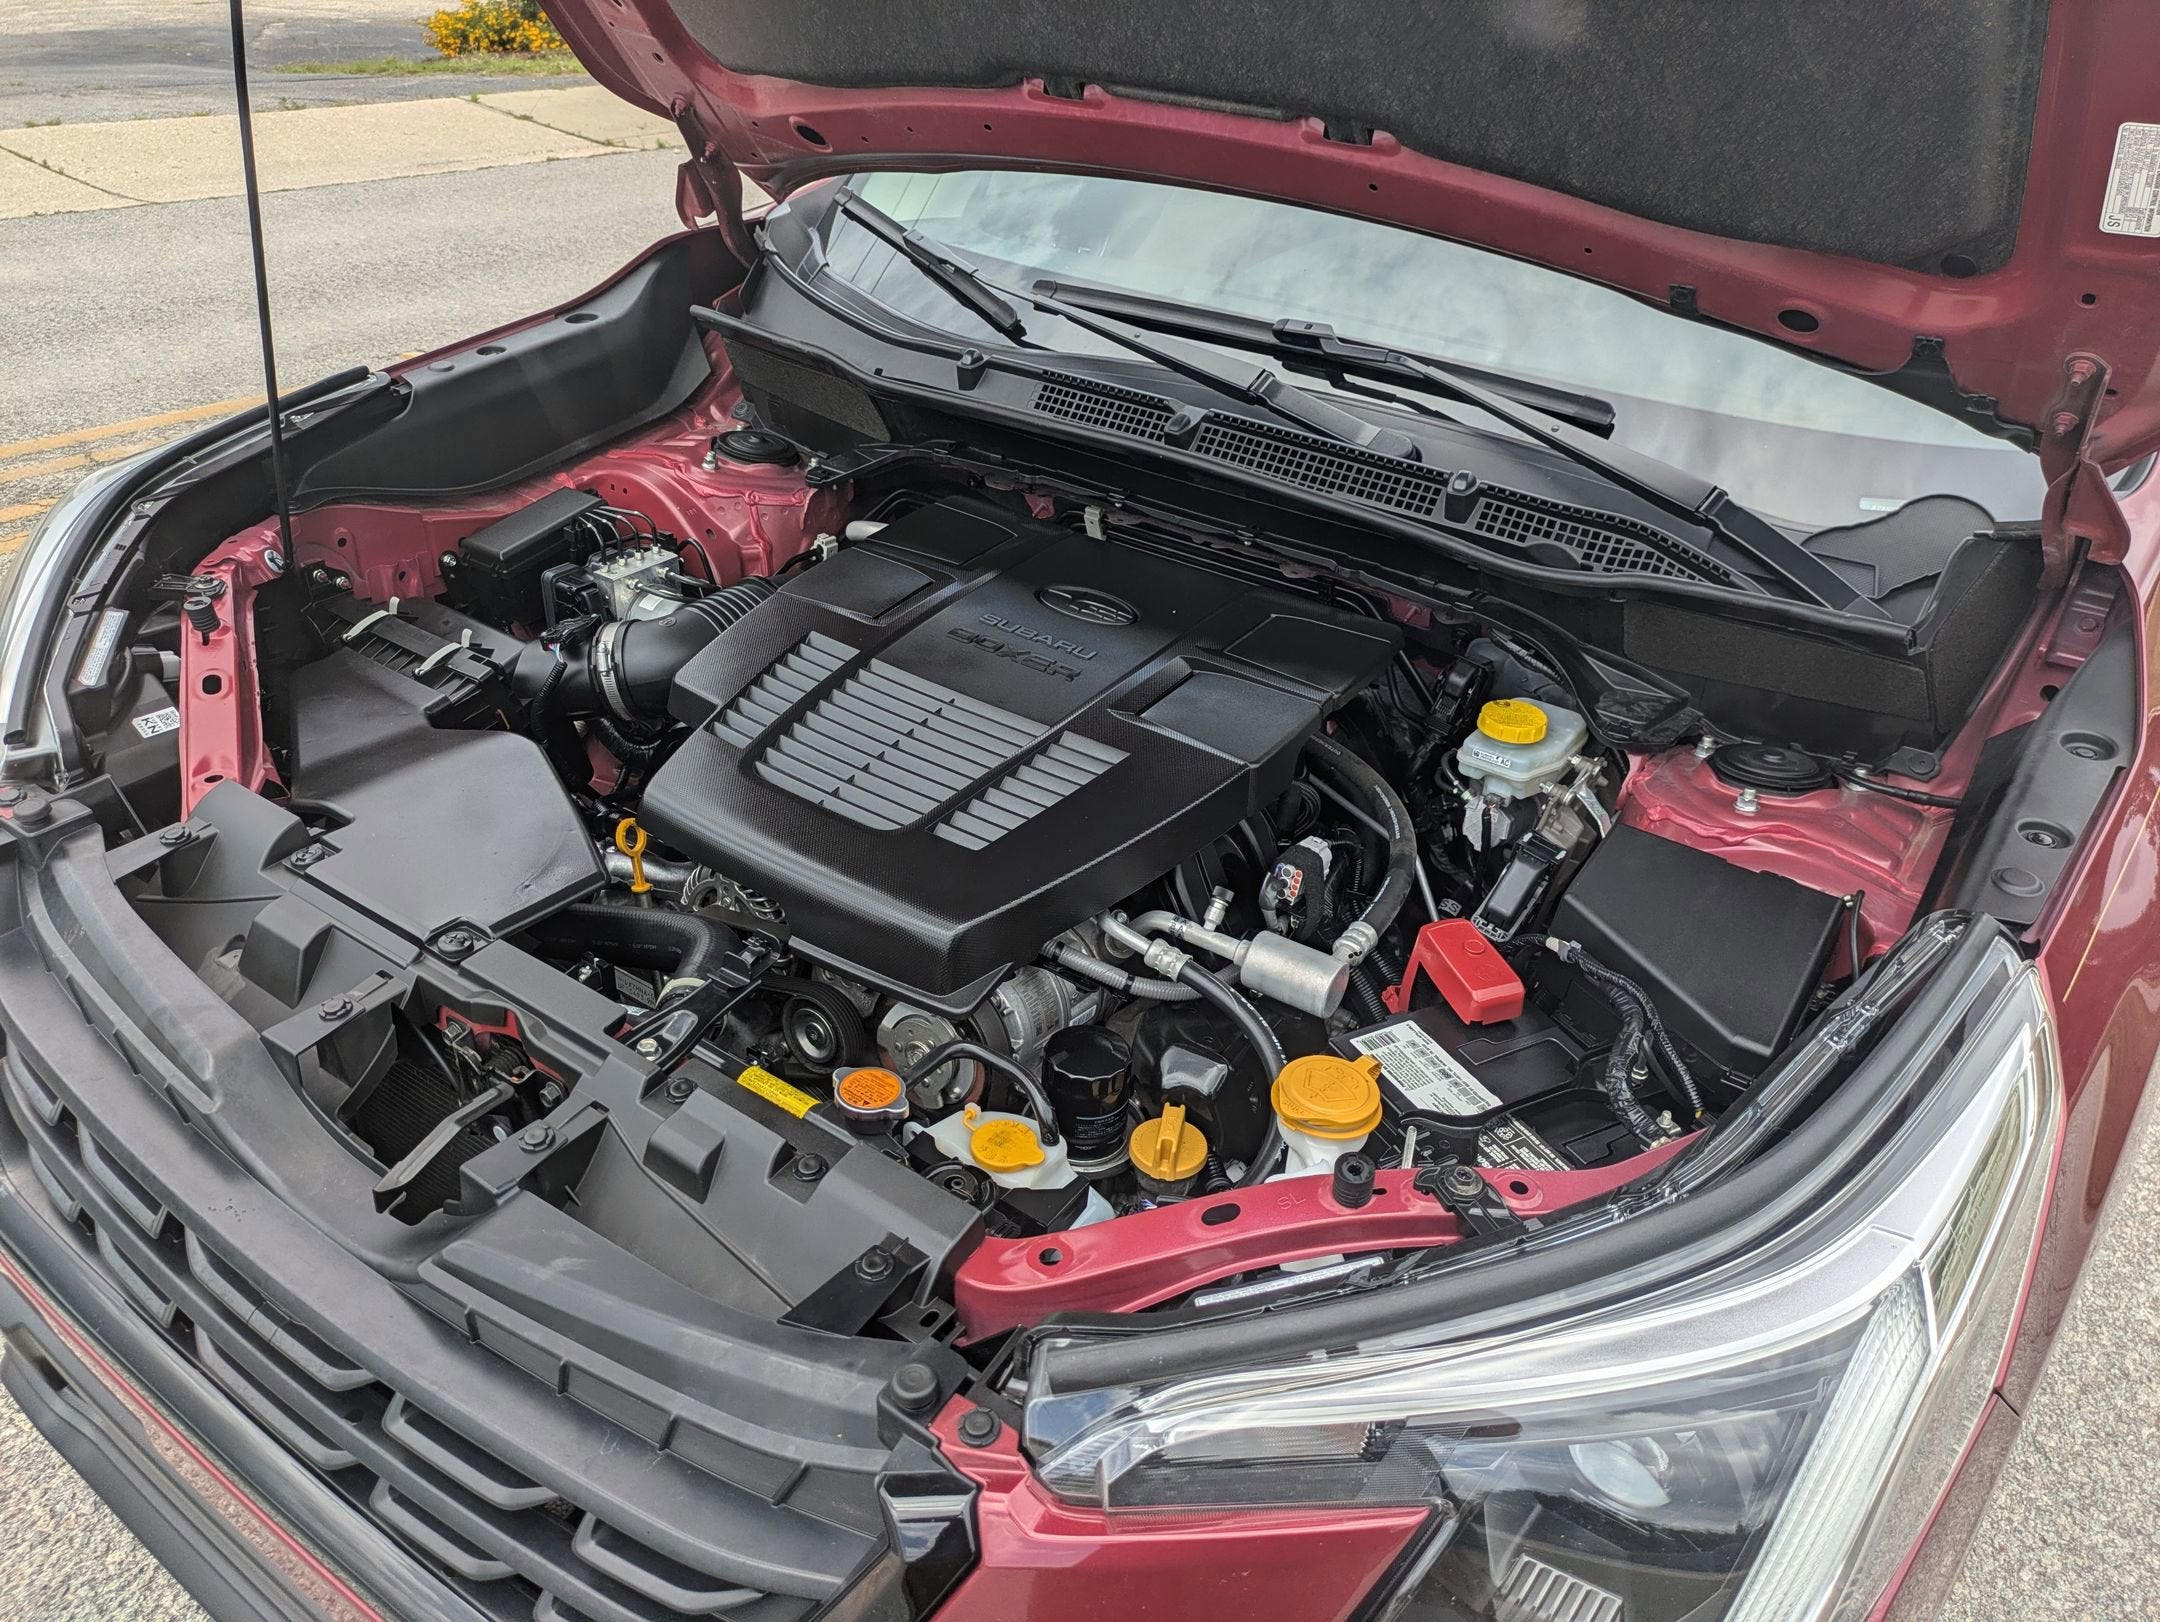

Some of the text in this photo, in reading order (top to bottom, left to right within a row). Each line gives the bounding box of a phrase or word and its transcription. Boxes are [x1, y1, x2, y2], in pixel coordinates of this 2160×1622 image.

[2107, 214, 2121, 228] JS
[979, 613, 1098, 661] SUBARU
[946, 626, 1082, 683] BOXER
[141, 717, 160, 735] KN
[1277, 1193, 1307, 1210] SL
